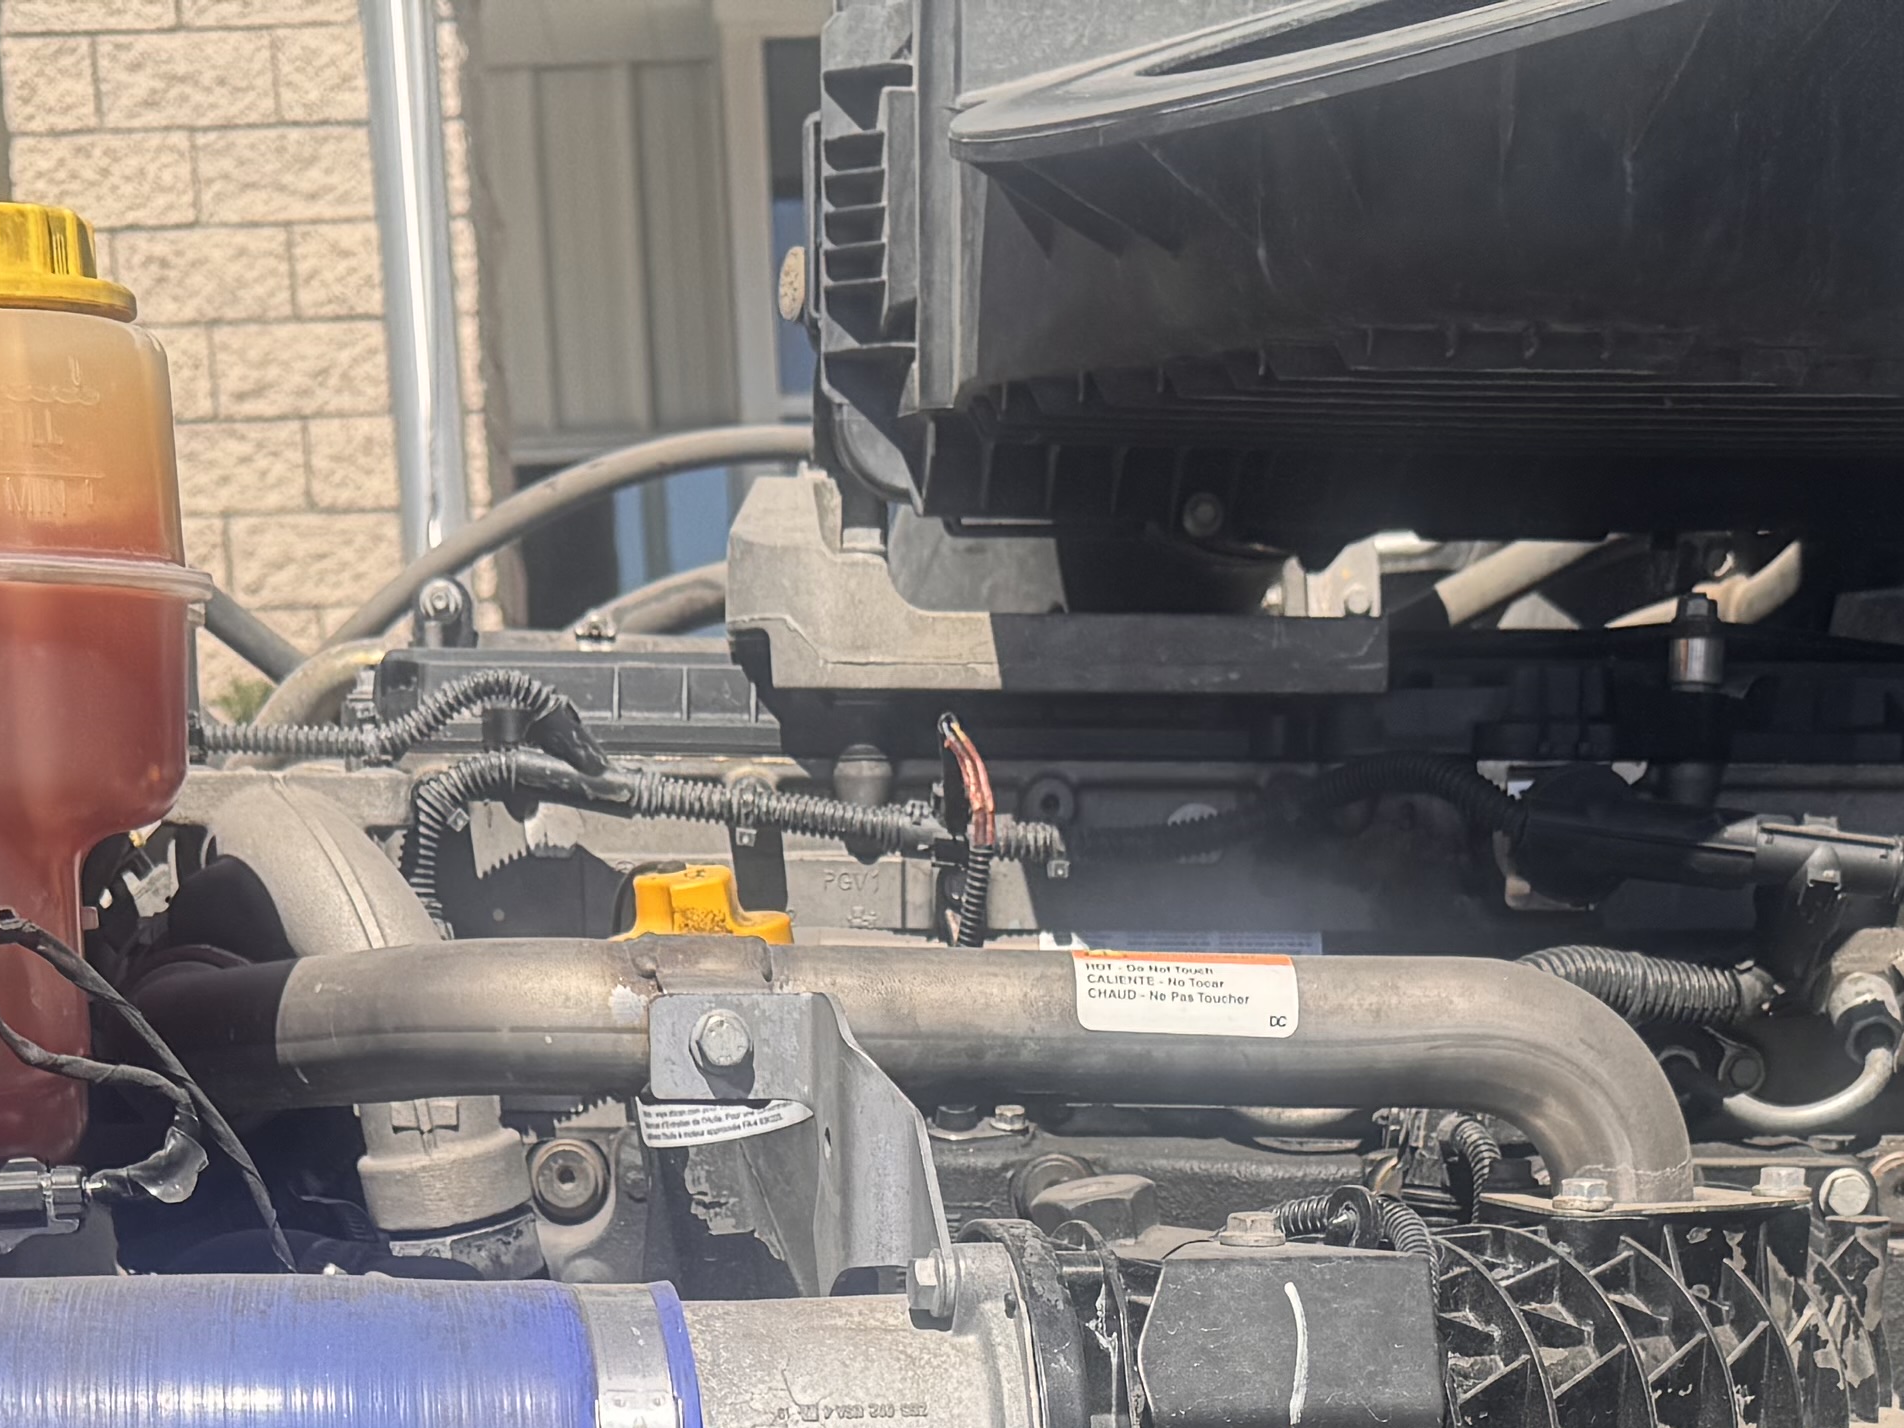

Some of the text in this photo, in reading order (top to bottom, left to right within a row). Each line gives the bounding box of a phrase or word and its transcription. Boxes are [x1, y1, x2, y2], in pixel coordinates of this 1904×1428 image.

[5, 478, 68, 515] MIN
[1175, 965, 1214, 976] Touch
[1168, 977, 1185, 988] No
[1087, 988, 1137, 1001] CHAUD
[1171, 991, 1194, 1003] Pas
[1269, 1015, 1286, 1027] DC
